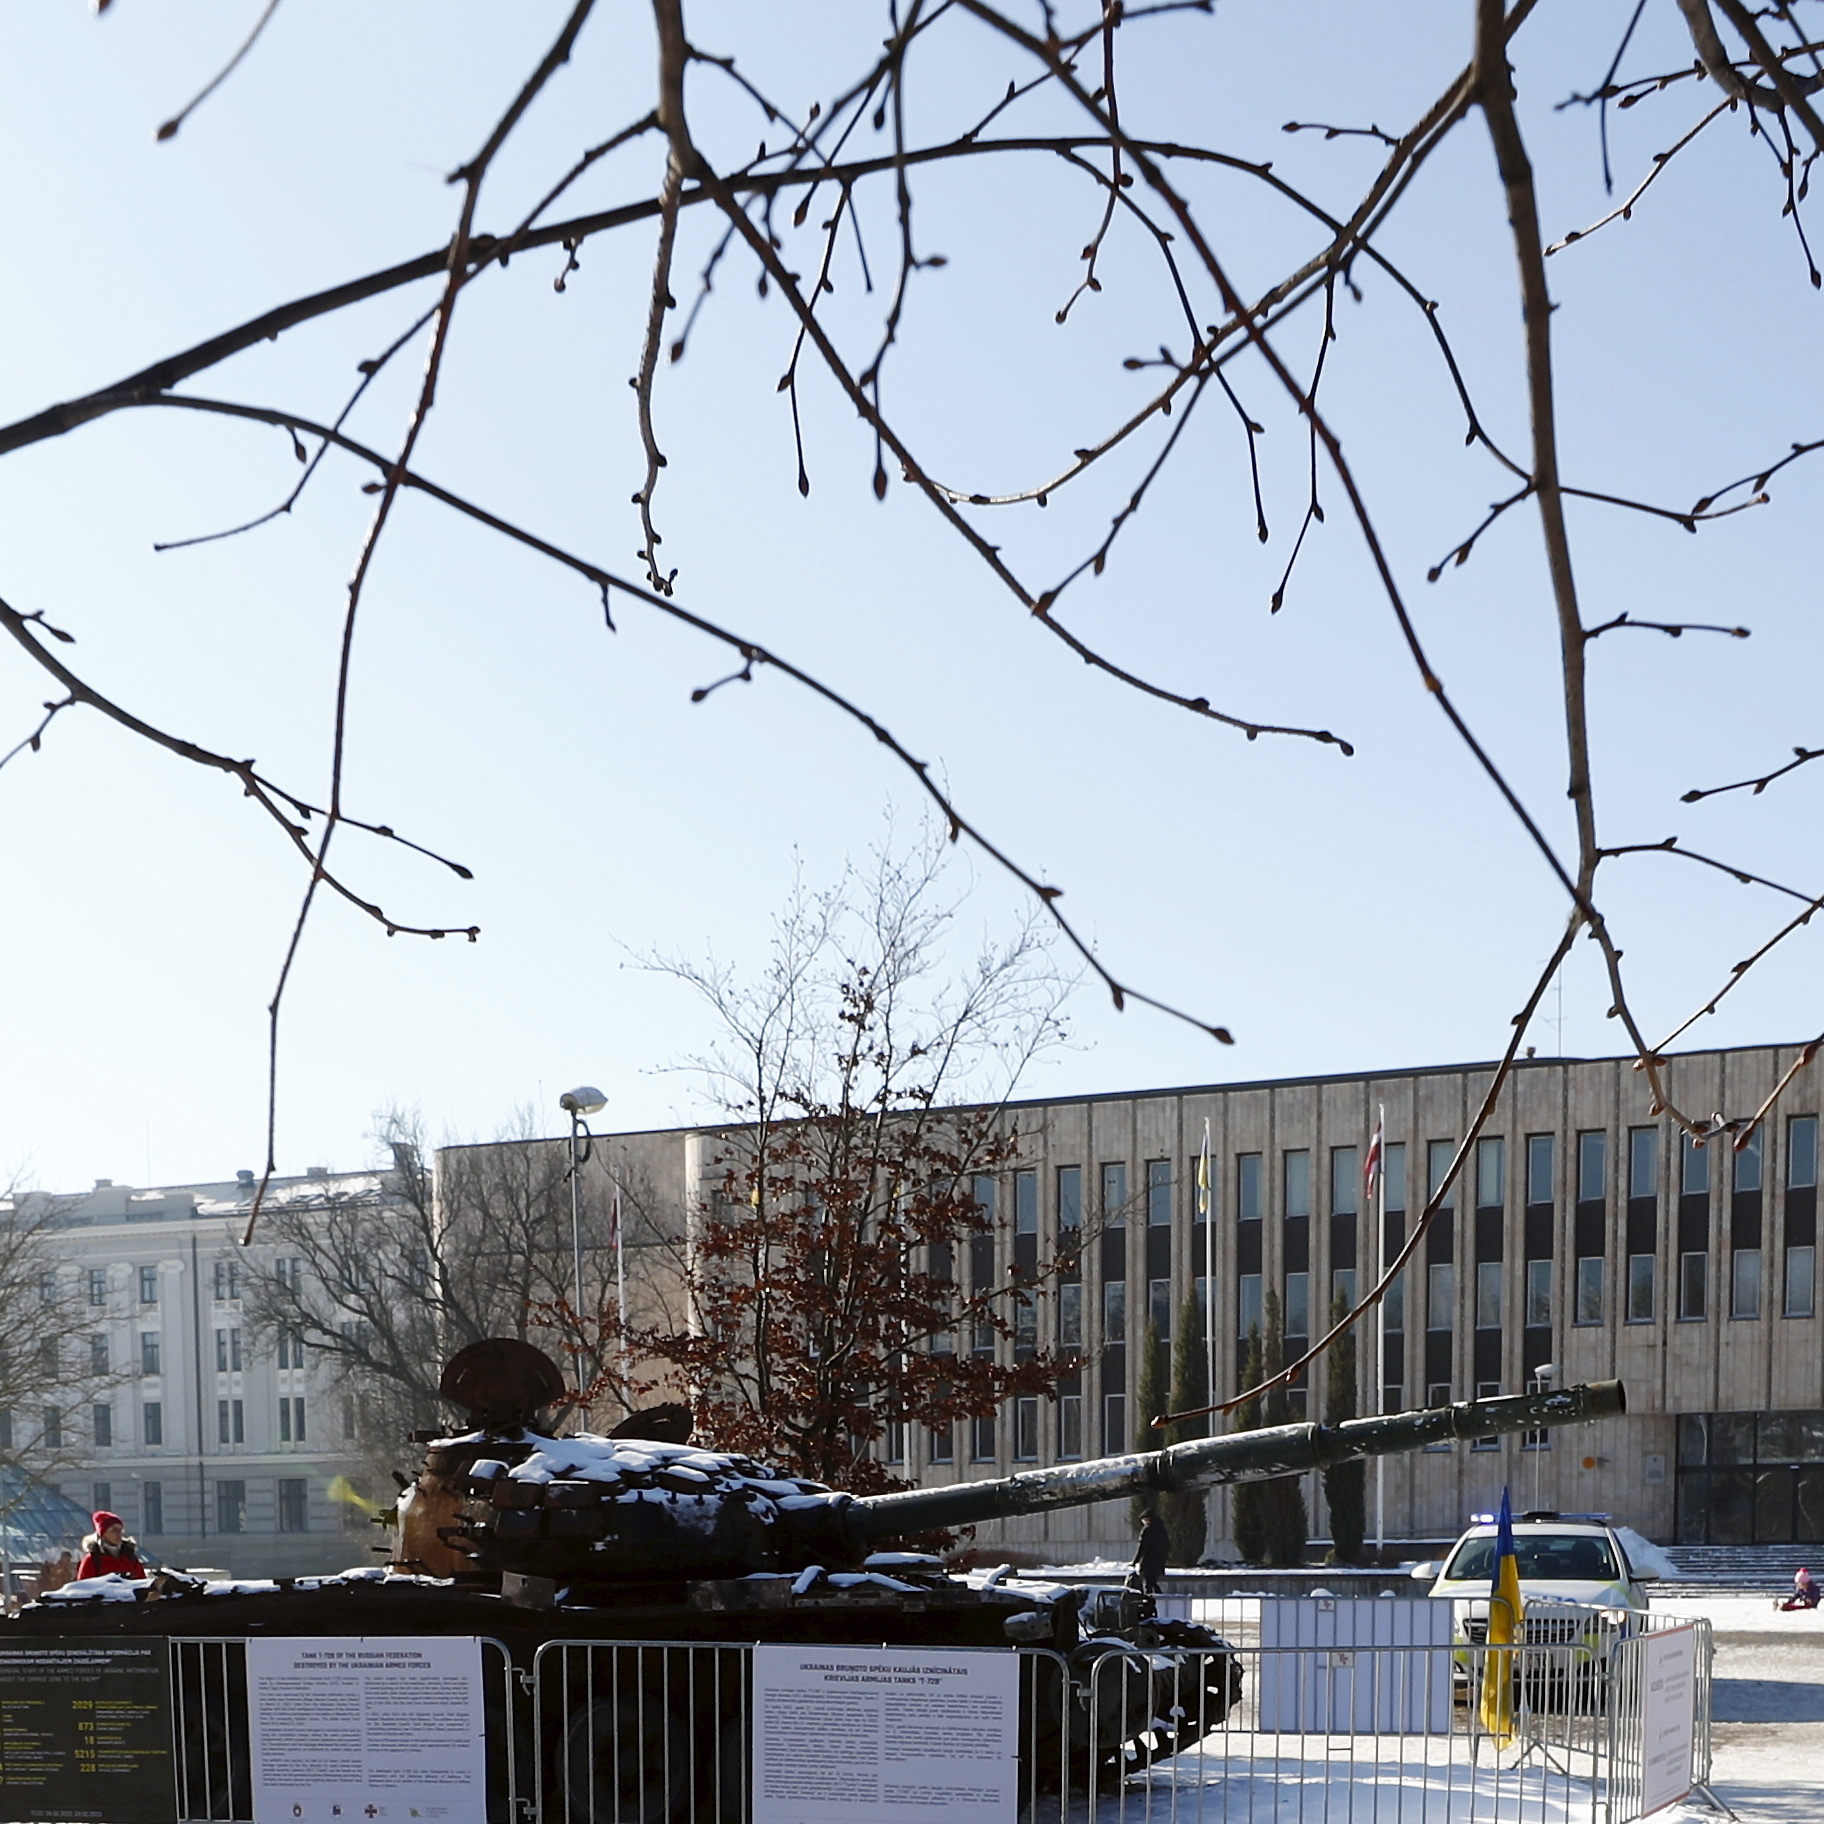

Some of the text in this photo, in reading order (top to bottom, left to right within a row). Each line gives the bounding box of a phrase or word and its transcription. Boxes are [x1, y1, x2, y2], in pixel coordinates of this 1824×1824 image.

[72, 1700, 94, 1709] 2029
[78, 1722, 94, 1731] 873
[74, 1750, 96, 1758] 5215
[80, 1764, 96, 1772] 228
